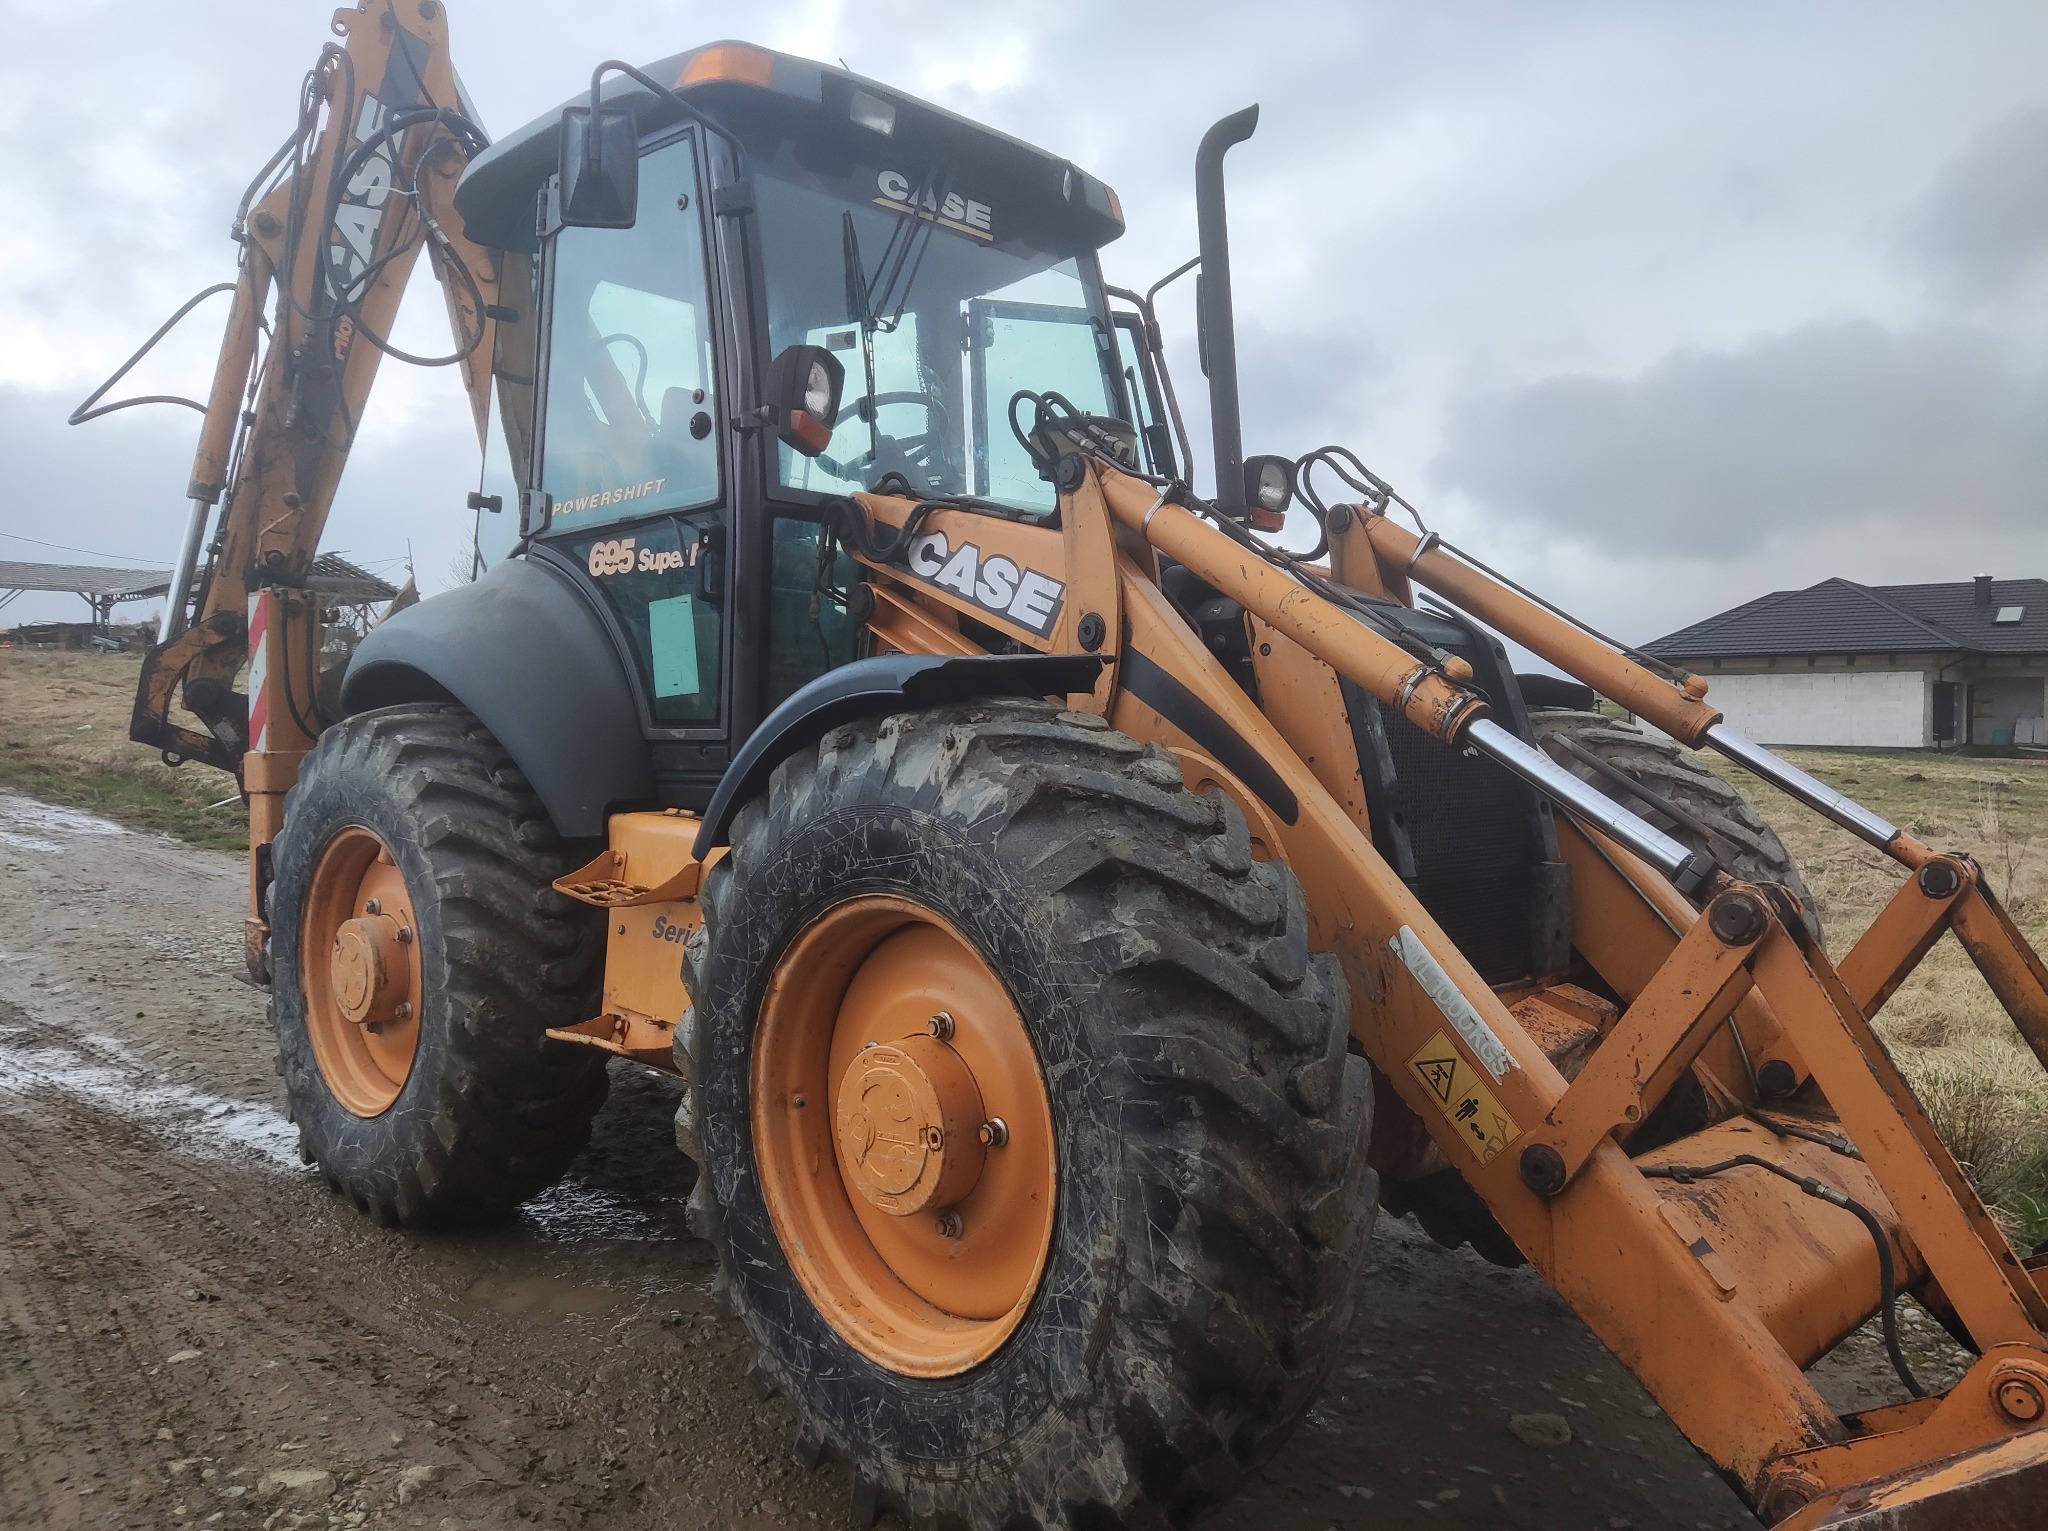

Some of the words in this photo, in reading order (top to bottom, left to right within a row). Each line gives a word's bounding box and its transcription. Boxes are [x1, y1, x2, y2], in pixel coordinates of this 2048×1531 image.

[325, 94, 404, 303] CASE
[877, 170, 992, 231] CASE
[552, 478, 666, 516] POWERSHIFT
[588, 538, 636, 577] 695
[638, 547, 689, 575] Supe
[908, 532, 1062, 630] CASE
[652, 916, 696, 946] Seri
